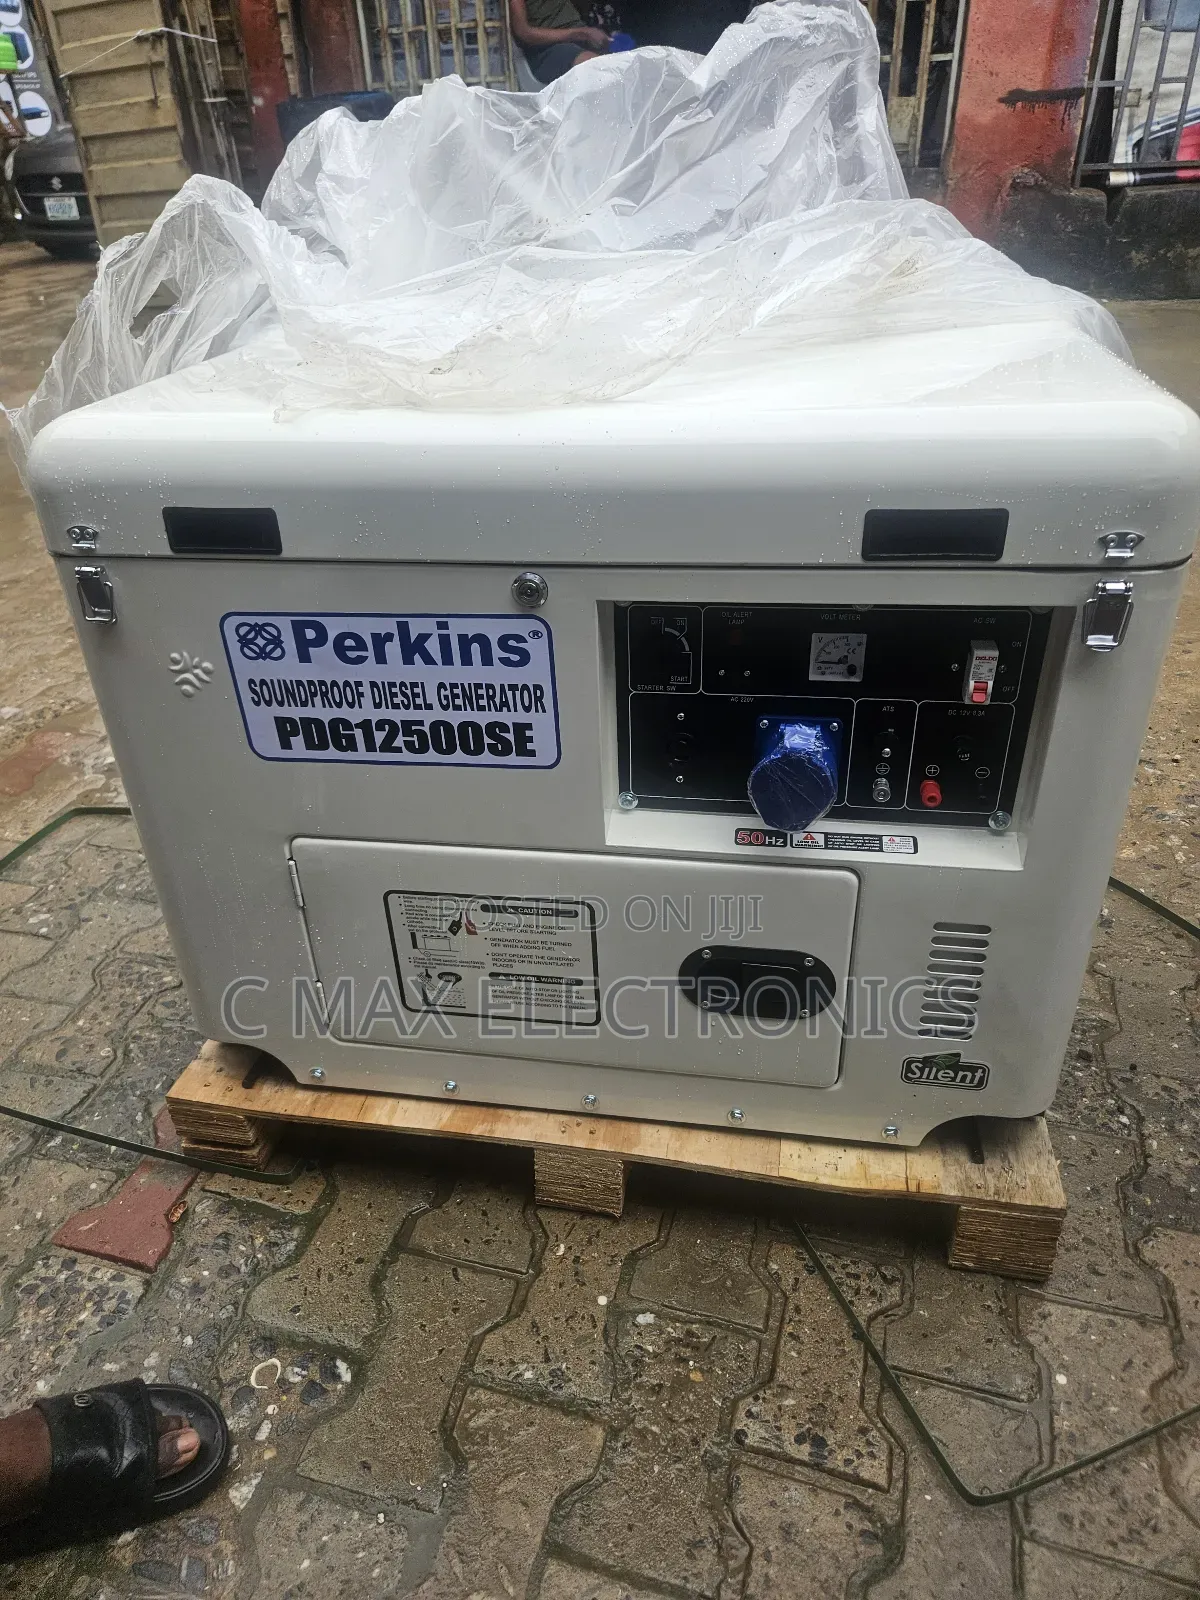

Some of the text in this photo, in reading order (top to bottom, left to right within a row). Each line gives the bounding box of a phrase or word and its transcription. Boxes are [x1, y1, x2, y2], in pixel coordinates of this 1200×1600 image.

[247, 678, 547, 713] SOUNDPROOF DIESEL GENERATOR
[273, 716, 537, 758] PDG12500SE
[736, 830, 784, 846] 50Hz
[518, 907, 552, 915] CAUTION
[540, 977, 576, 985] WARNING
[906, 1061, 984, 1085] Silent
